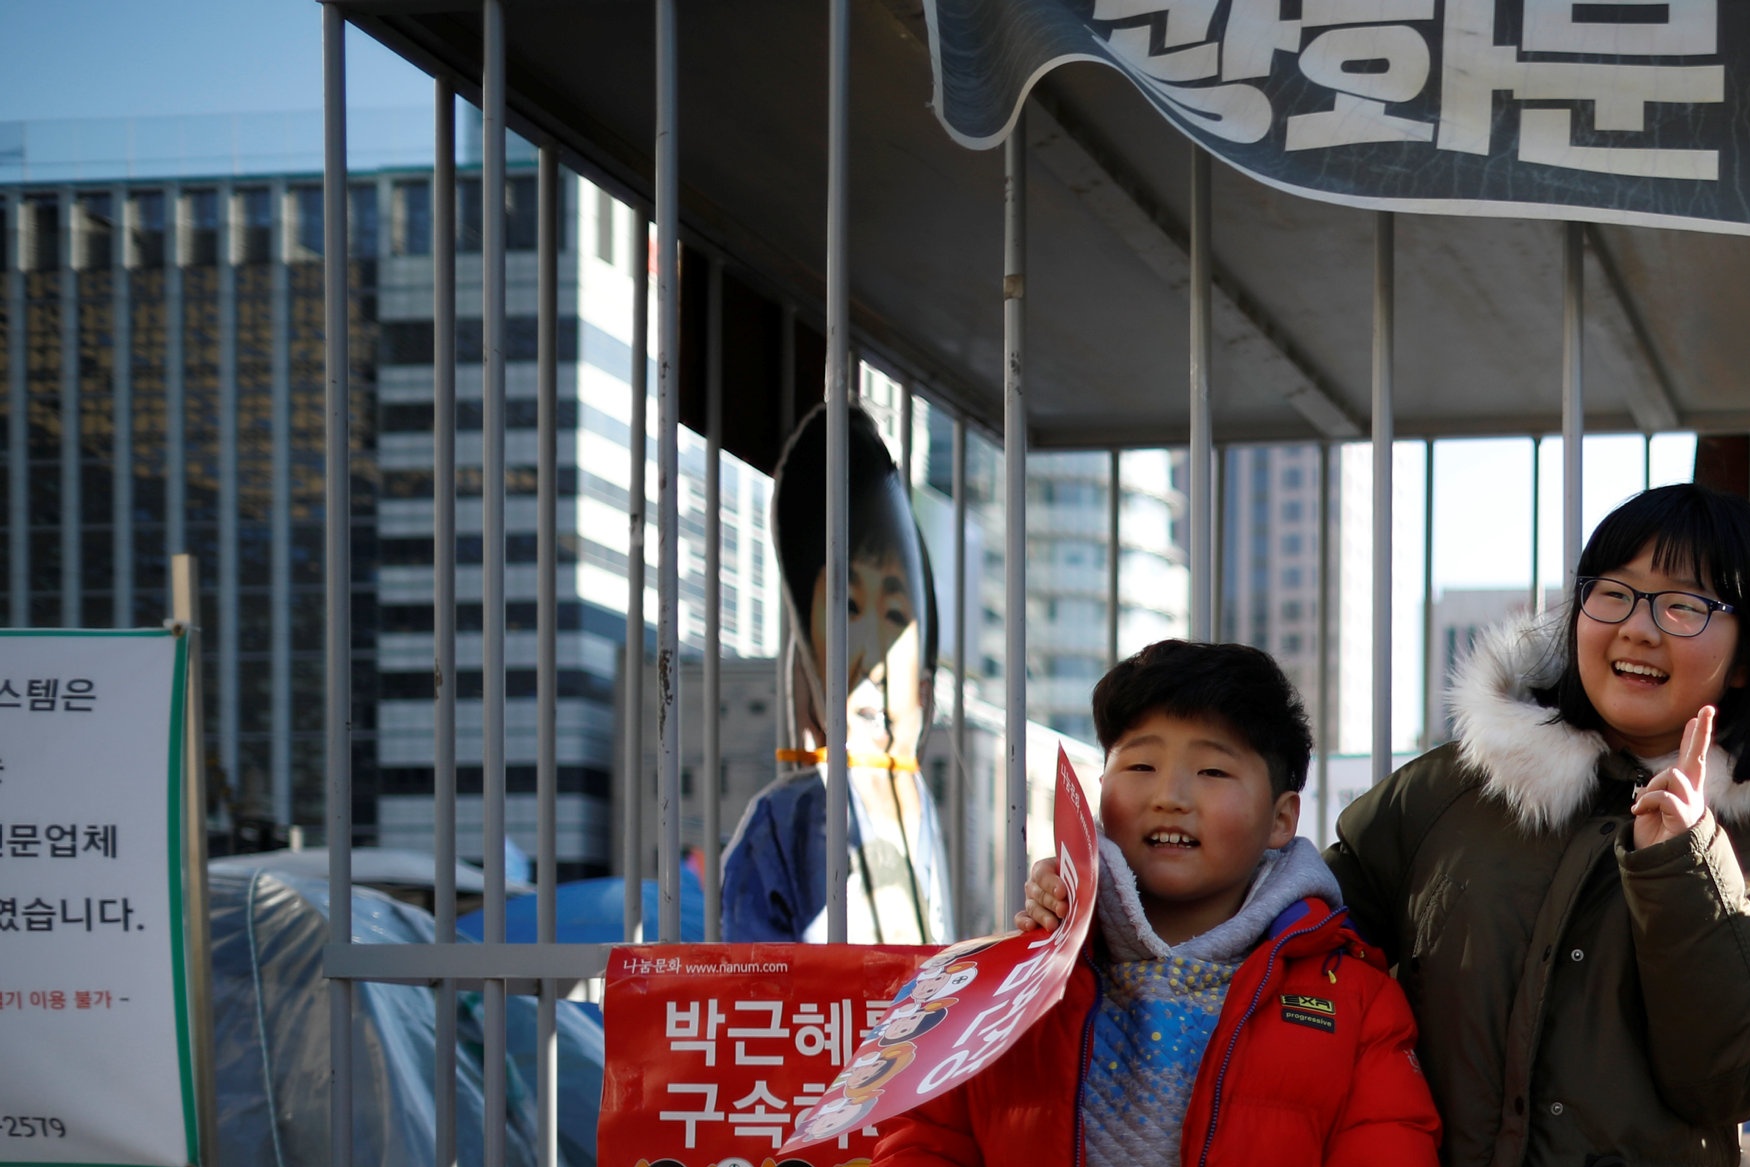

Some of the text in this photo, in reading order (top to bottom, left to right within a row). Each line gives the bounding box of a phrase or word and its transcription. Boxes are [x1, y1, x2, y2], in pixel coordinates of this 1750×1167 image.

[0, 678, 97, 712] 스템은
[0, 823, 118, 859] 문업체
[624, 956, 788, 975] 나눔문화 www.nanum.com
[0, 990, 22, 1010] 기
[29, 990, 66, 1010] 이용
[74, 990, 112, 1009] 불가
[1286, 1010, 1333, 1028] progressive
[659, 1080, 879, 1149] 구속
